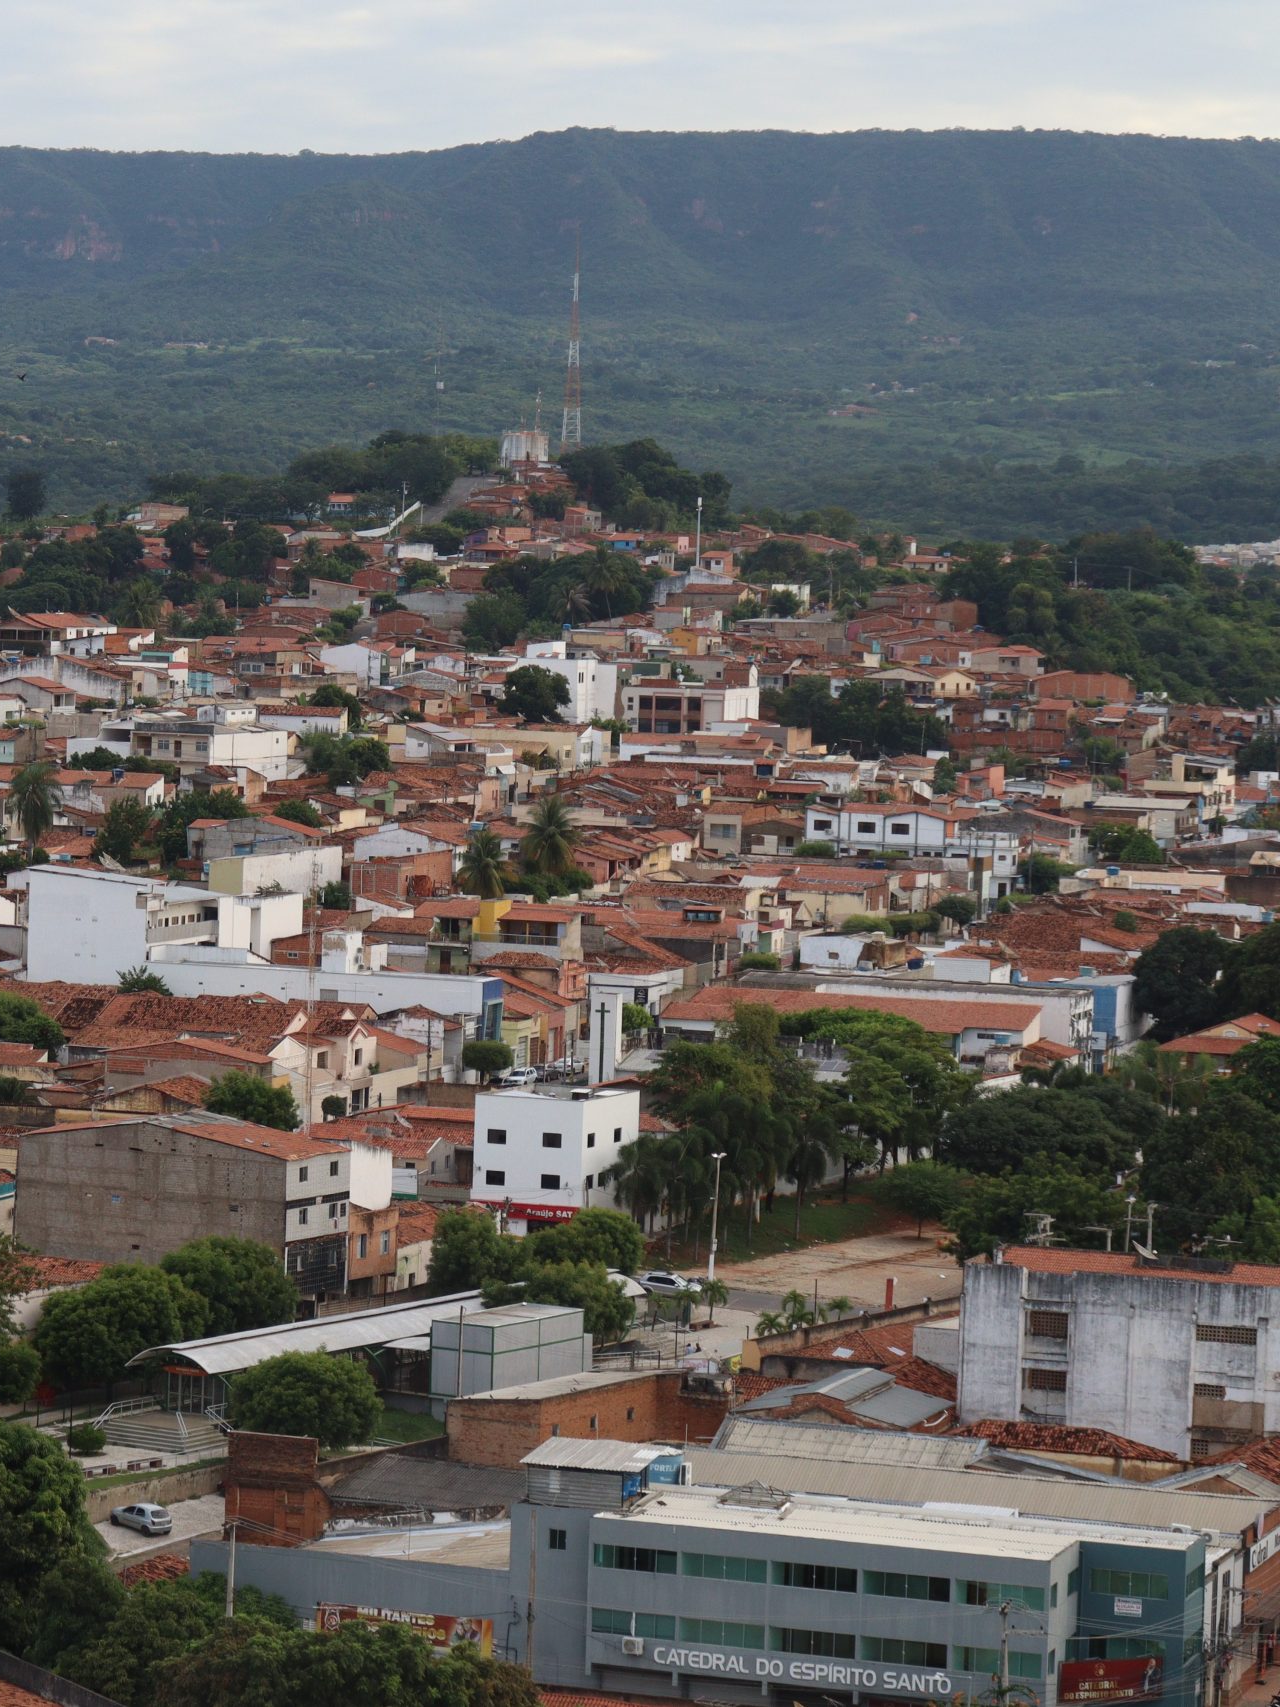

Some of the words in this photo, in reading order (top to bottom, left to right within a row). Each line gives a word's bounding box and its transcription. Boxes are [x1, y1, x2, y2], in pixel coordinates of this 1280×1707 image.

[526, 1208, 554, 1219] Araújo
[556, 1210, 573, 1219] SAT
[357, 1607, 435, 1625] MILITANTES
[653, 1647, 749, 1674] CATEDRAL
[756, 1658, 784, 1677] DO
[790, 1661, 877, 1686] ESPÍRITO
[883, 1670, 952, 1695] SANTO
